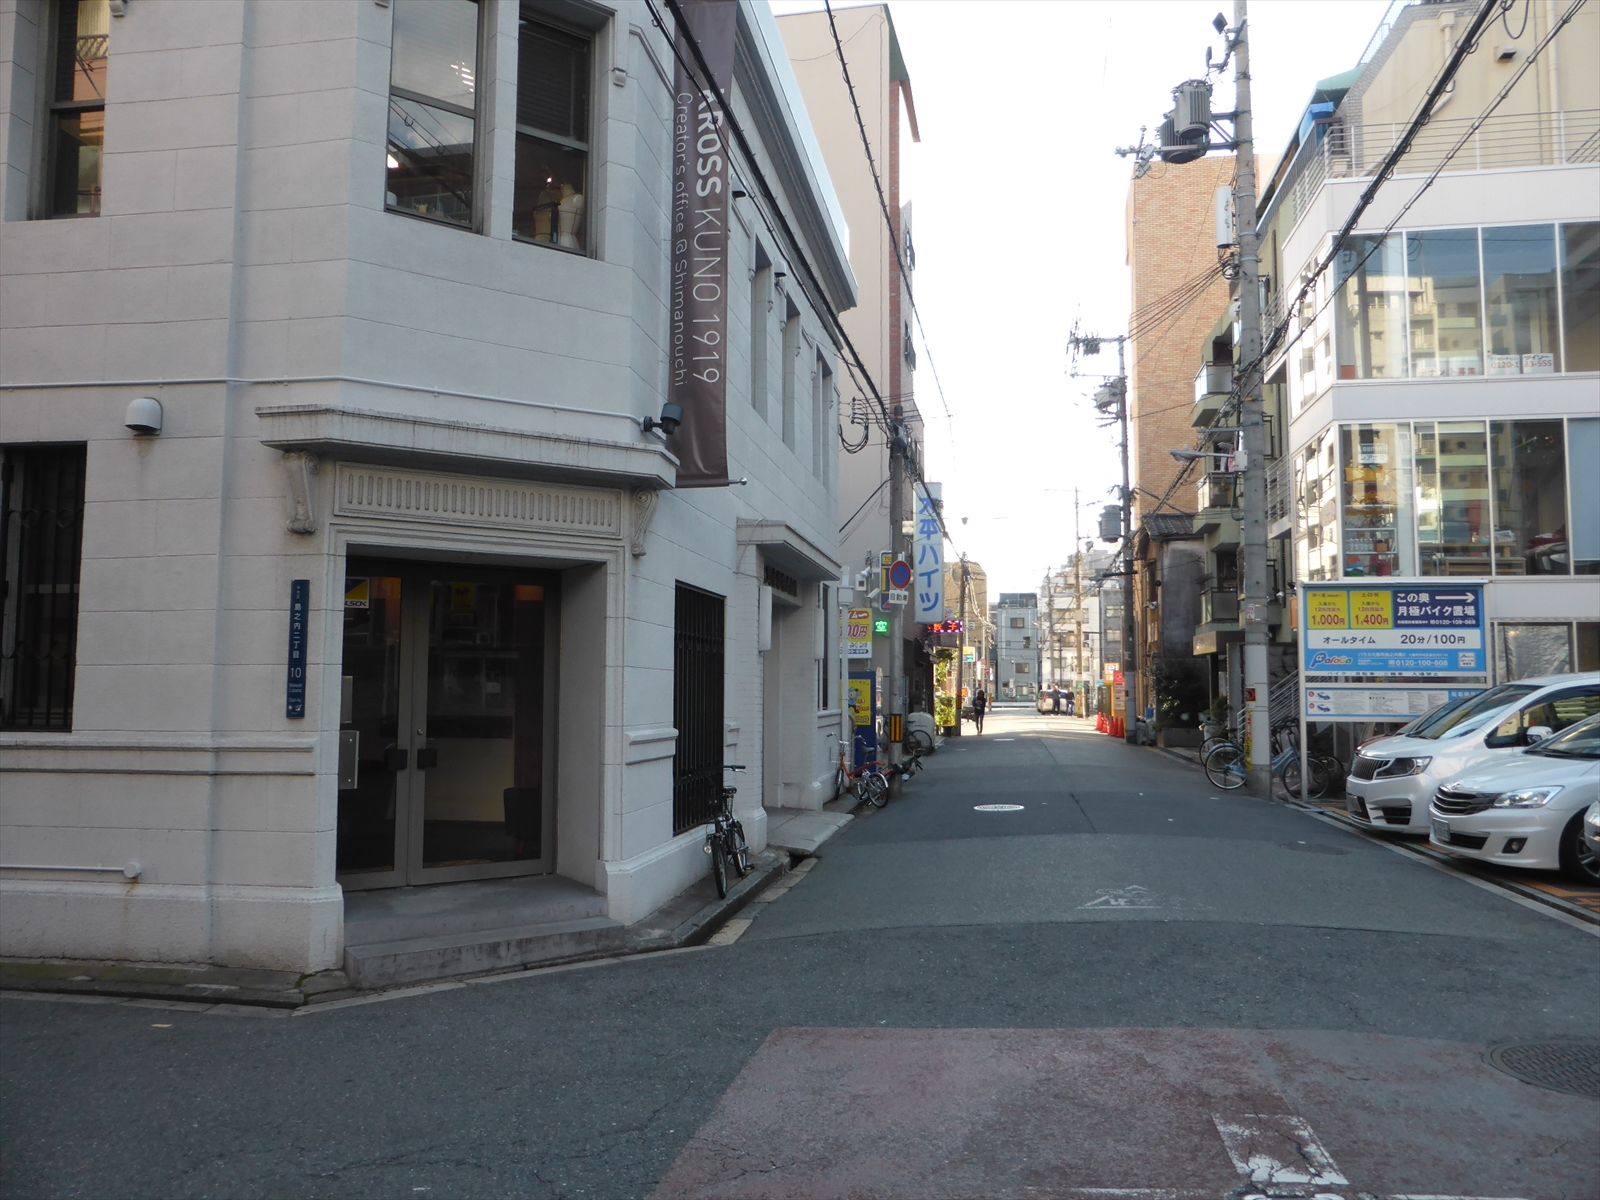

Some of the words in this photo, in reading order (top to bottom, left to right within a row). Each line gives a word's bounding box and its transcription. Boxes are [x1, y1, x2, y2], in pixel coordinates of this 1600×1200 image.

[675, 92, 693, 176] Creator's
[675, 181, 689, 233] office
[675, 239, 688, 255] @
[692, 208, 721, 302] KUNO
[674, 259, 688, 387] Shimanouchi
[692, 314, 721, 383] 1919
[1396, 592, 1430, 604] この奥
[1397, 605, 1476, 617] 月極バイク置場
[875, 620, 888, 632] 空
[1322, 636, 1376, 644] オールタイム
[290, 667, 302, 678] 10
